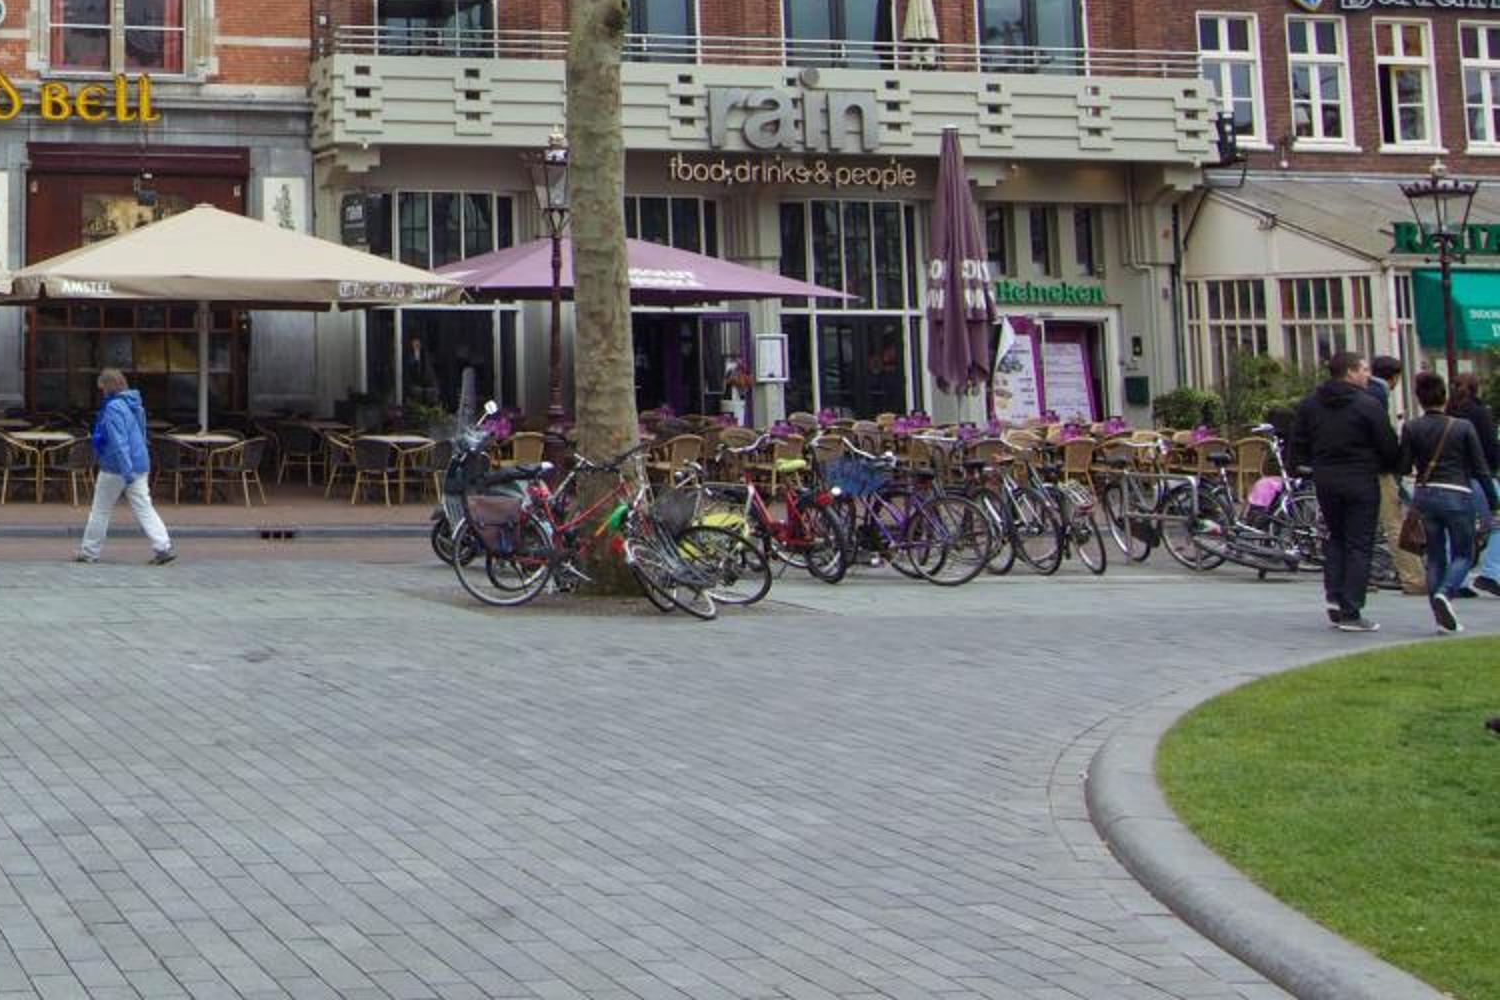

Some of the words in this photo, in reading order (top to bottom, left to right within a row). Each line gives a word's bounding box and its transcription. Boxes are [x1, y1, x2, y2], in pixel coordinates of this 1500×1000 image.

[707, 67, 880, 152] rain
[834, 161, 918, 190] people
[60, 279, 112, 294] AMSTEL
[996, 279, 1106, 306] Heineken
